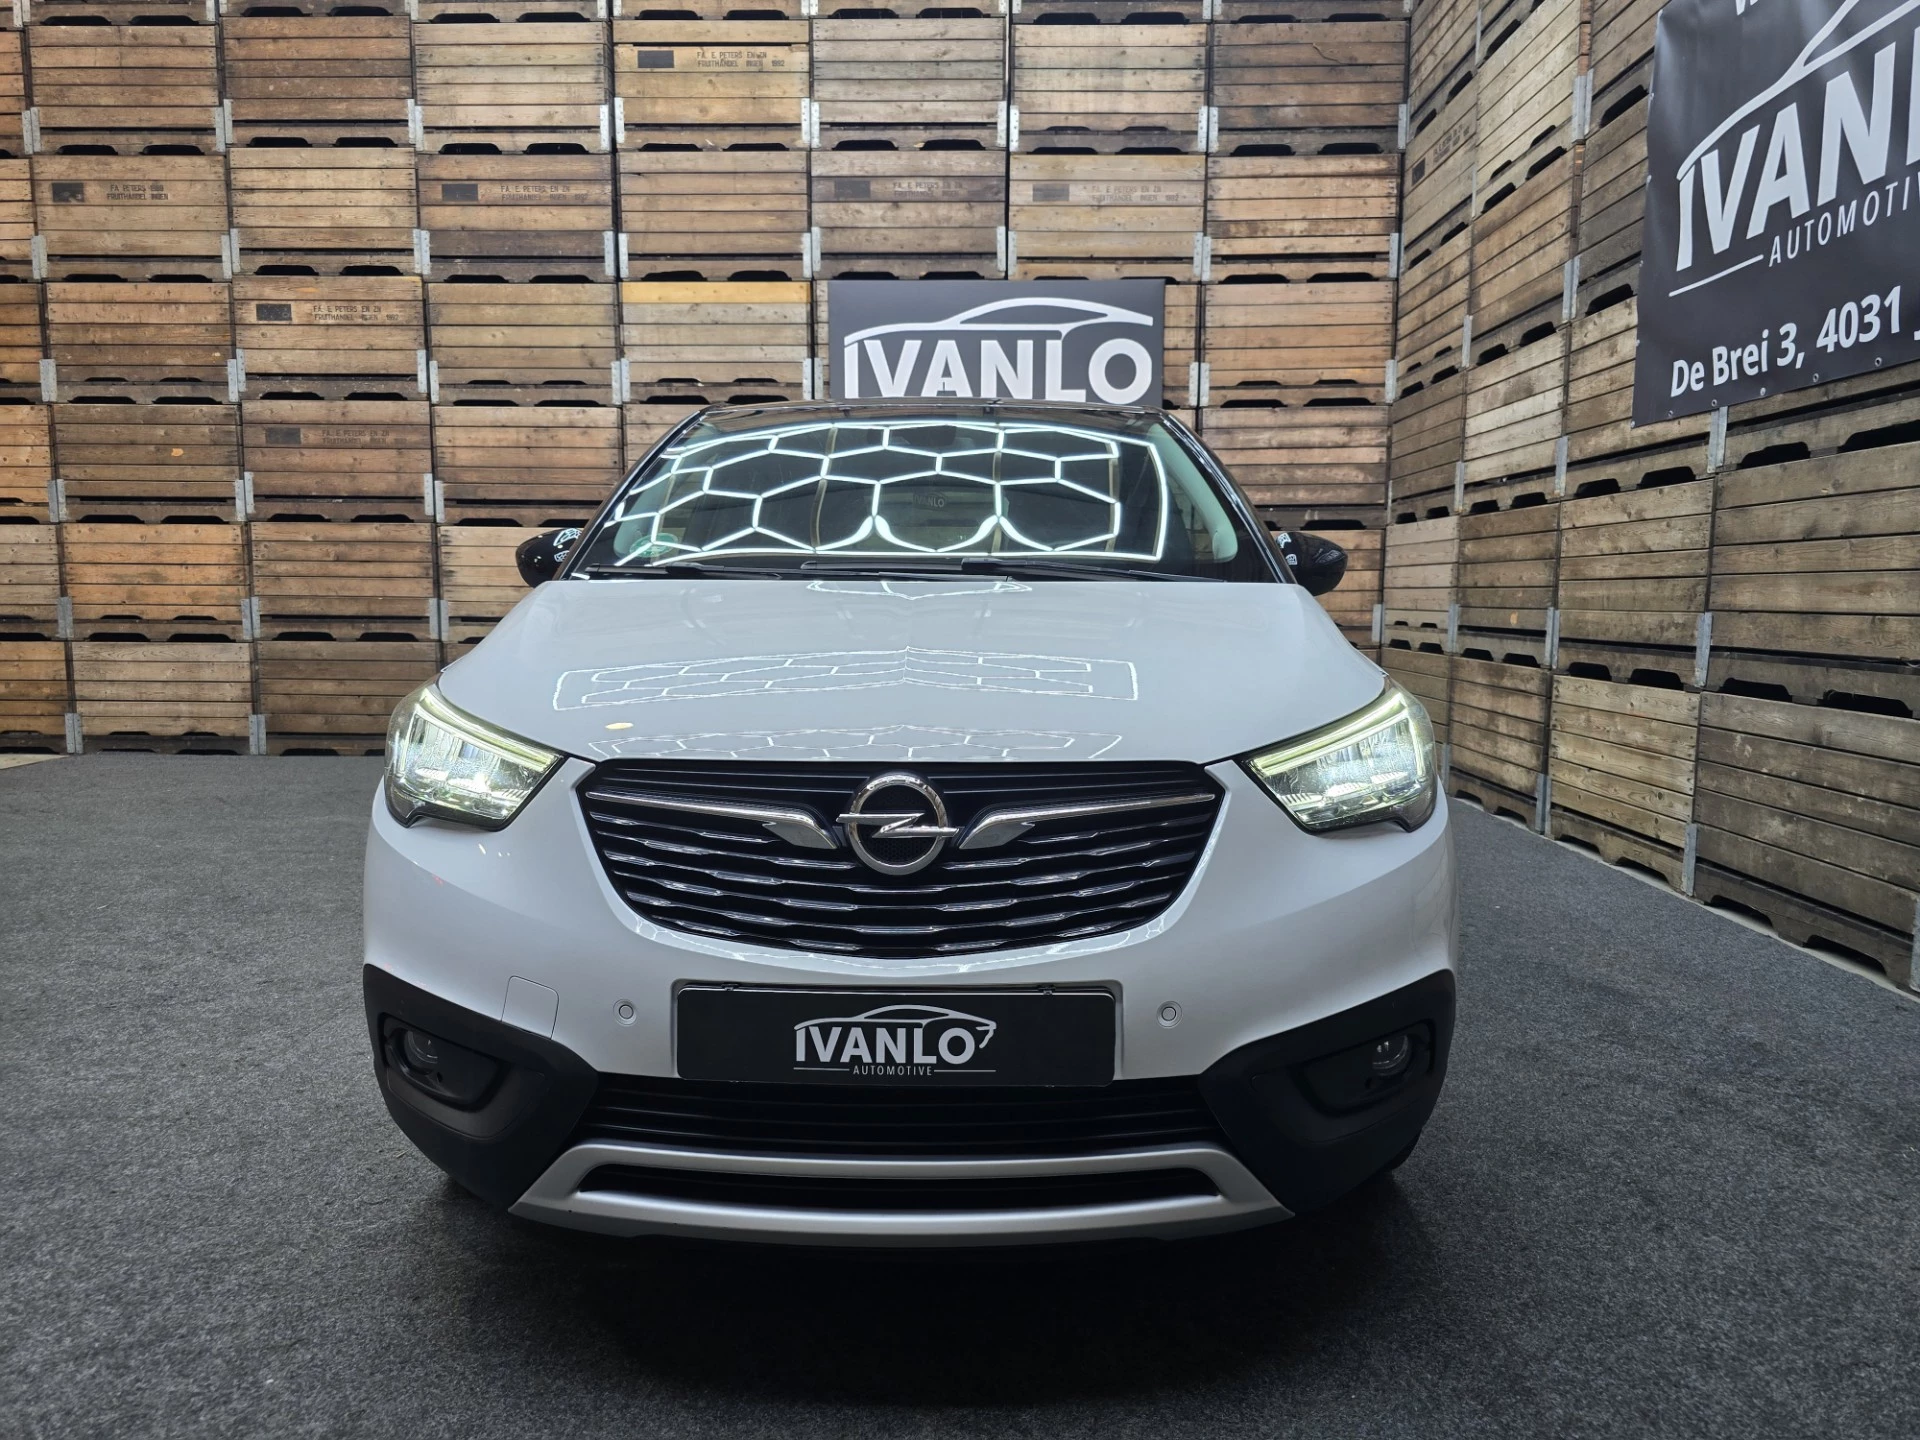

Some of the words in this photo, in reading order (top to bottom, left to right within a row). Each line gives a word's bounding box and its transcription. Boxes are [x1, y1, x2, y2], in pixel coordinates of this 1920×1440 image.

[122, 184, 146, 192] PETERS
[1768, 172, 1920, 267] AUTOMOTI
[1670, 359, 1705, 398] De
[1712, 328, 1770, 386] Brei
[1776, 322, 1806, 369] 3,
[1815, 285, 1902, 353] 4031
[844, 338, 1152, 405] IVANLO
[795, 1026, 976, 1065] IVANLO
[852, 1065, 933, 1076] AUTOMOTIVE
